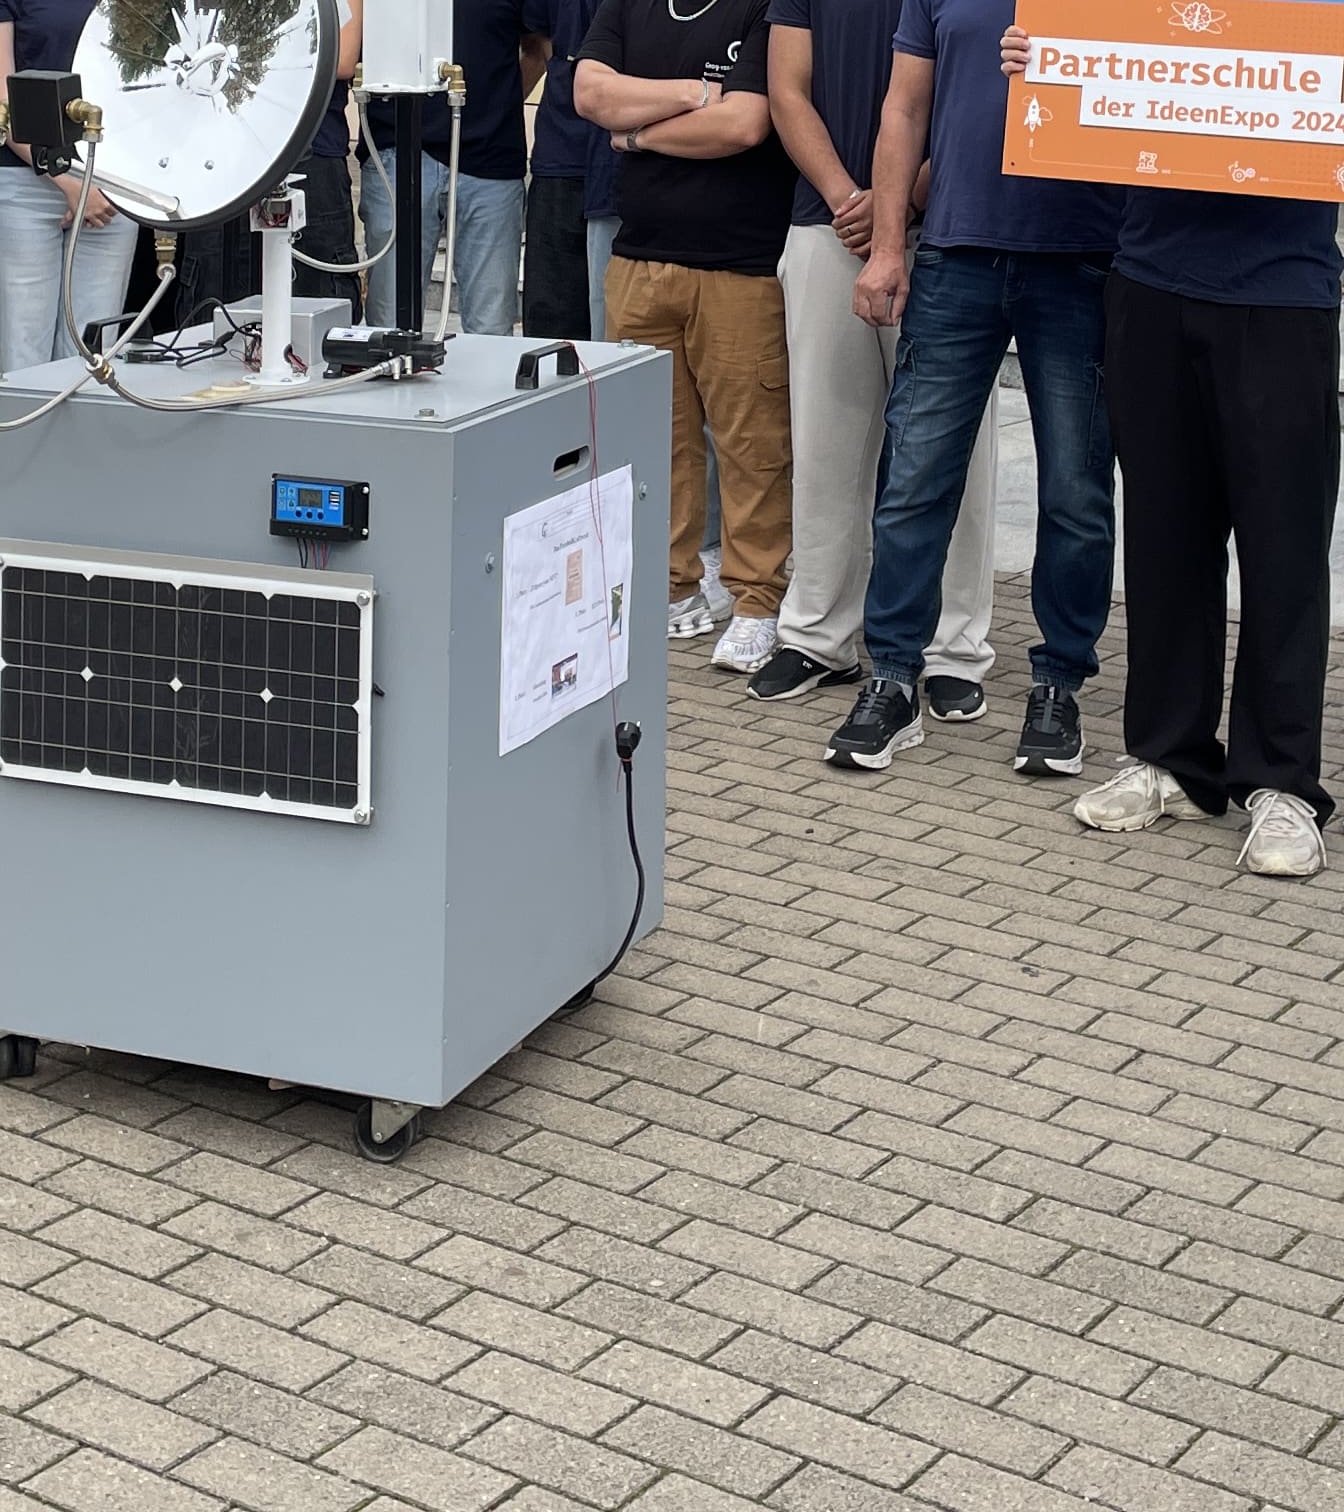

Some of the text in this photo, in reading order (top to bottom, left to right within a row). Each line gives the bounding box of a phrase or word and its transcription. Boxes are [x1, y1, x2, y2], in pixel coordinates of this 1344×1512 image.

[1038, 46, 1322, 95] Partnerschule
[1092, 96, 1136, 118] der
[1145, 100, 1280, 132] IdeenExpo
